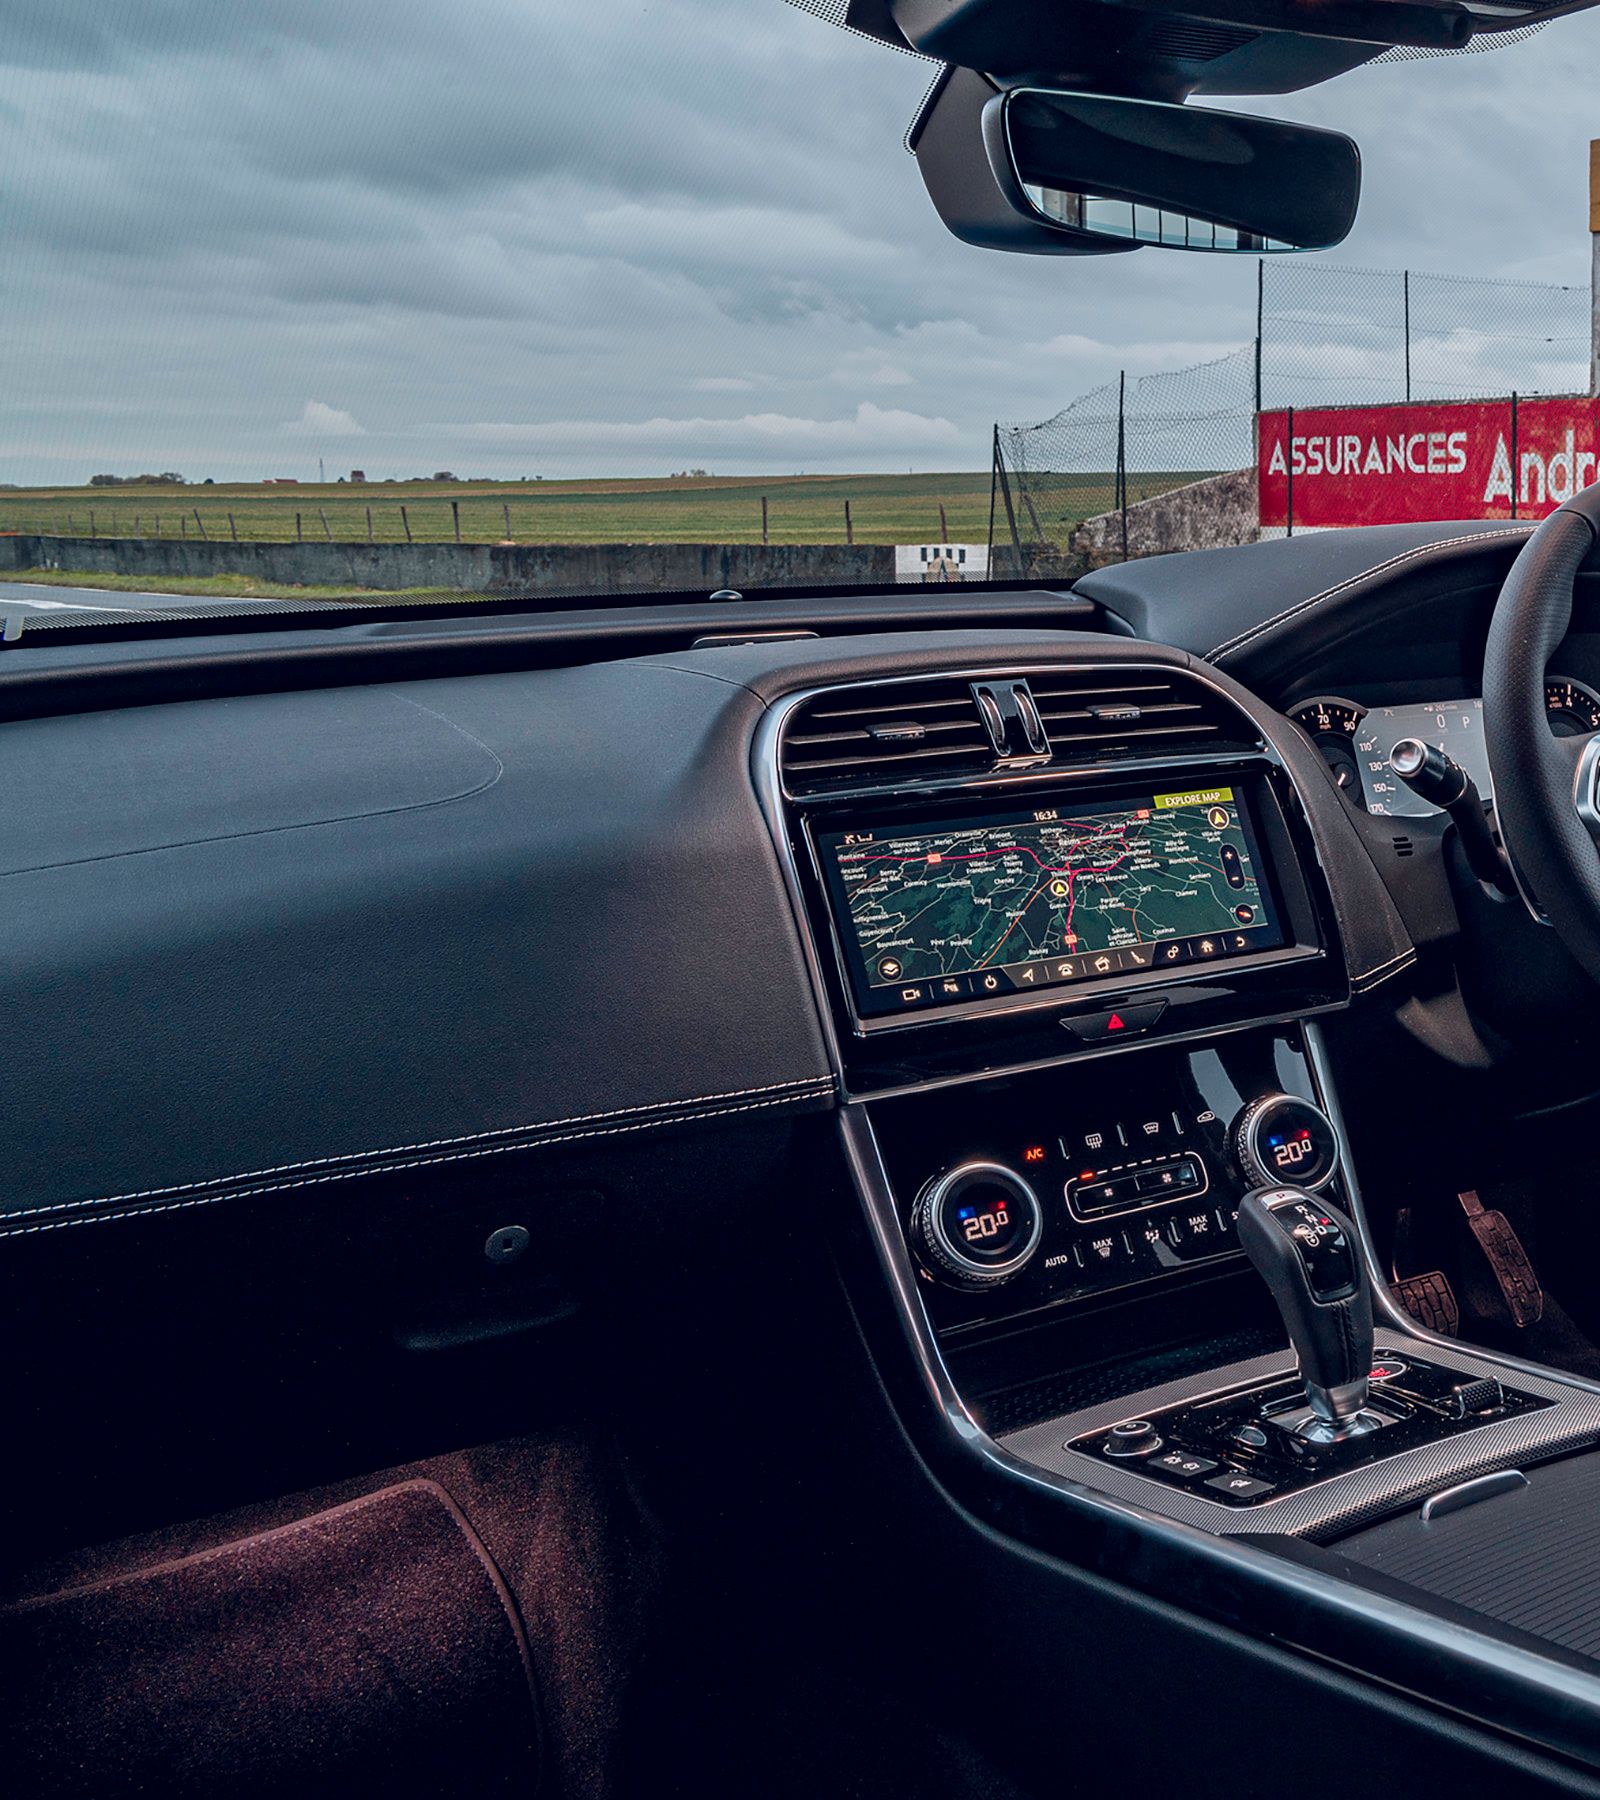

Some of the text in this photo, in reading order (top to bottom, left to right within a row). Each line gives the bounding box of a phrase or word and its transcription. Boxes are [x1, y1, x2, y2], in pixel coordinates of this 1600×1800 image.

[1267, 432, 1468, 476] ASSURANCES
[1566, 697, 1573, 707] 4
[1318, 715, 1330, 724] 70
[1462, 716, 1470, 728] P
[1591, 715, 1599, 726] 5
[1344, 721, 1356, 731] 90
[1359, 742, 1372, 751] 110
[1369, 761, 1383, 771] 130
[1373, 782, 1387, 792] 150
[1165, 791, 1221, 807] EXPLORE MAP
[1370, 803, 1384, 812] 170
[1033, 810, 1058, 821] 16:34
[1026, 1148, 1044, 1160] A/C
[1274, 1138, 1313, 1167] 20.0
[962, 1210, 1009, 1242] 20.0
[1188, 1215, 1209, 1227] MAX
[1193, 1224, 1209, 1234] A/C
[1092, 1238, 1114, 1250] MAX
[1044, 1254, 1068, 1268] AUTO
